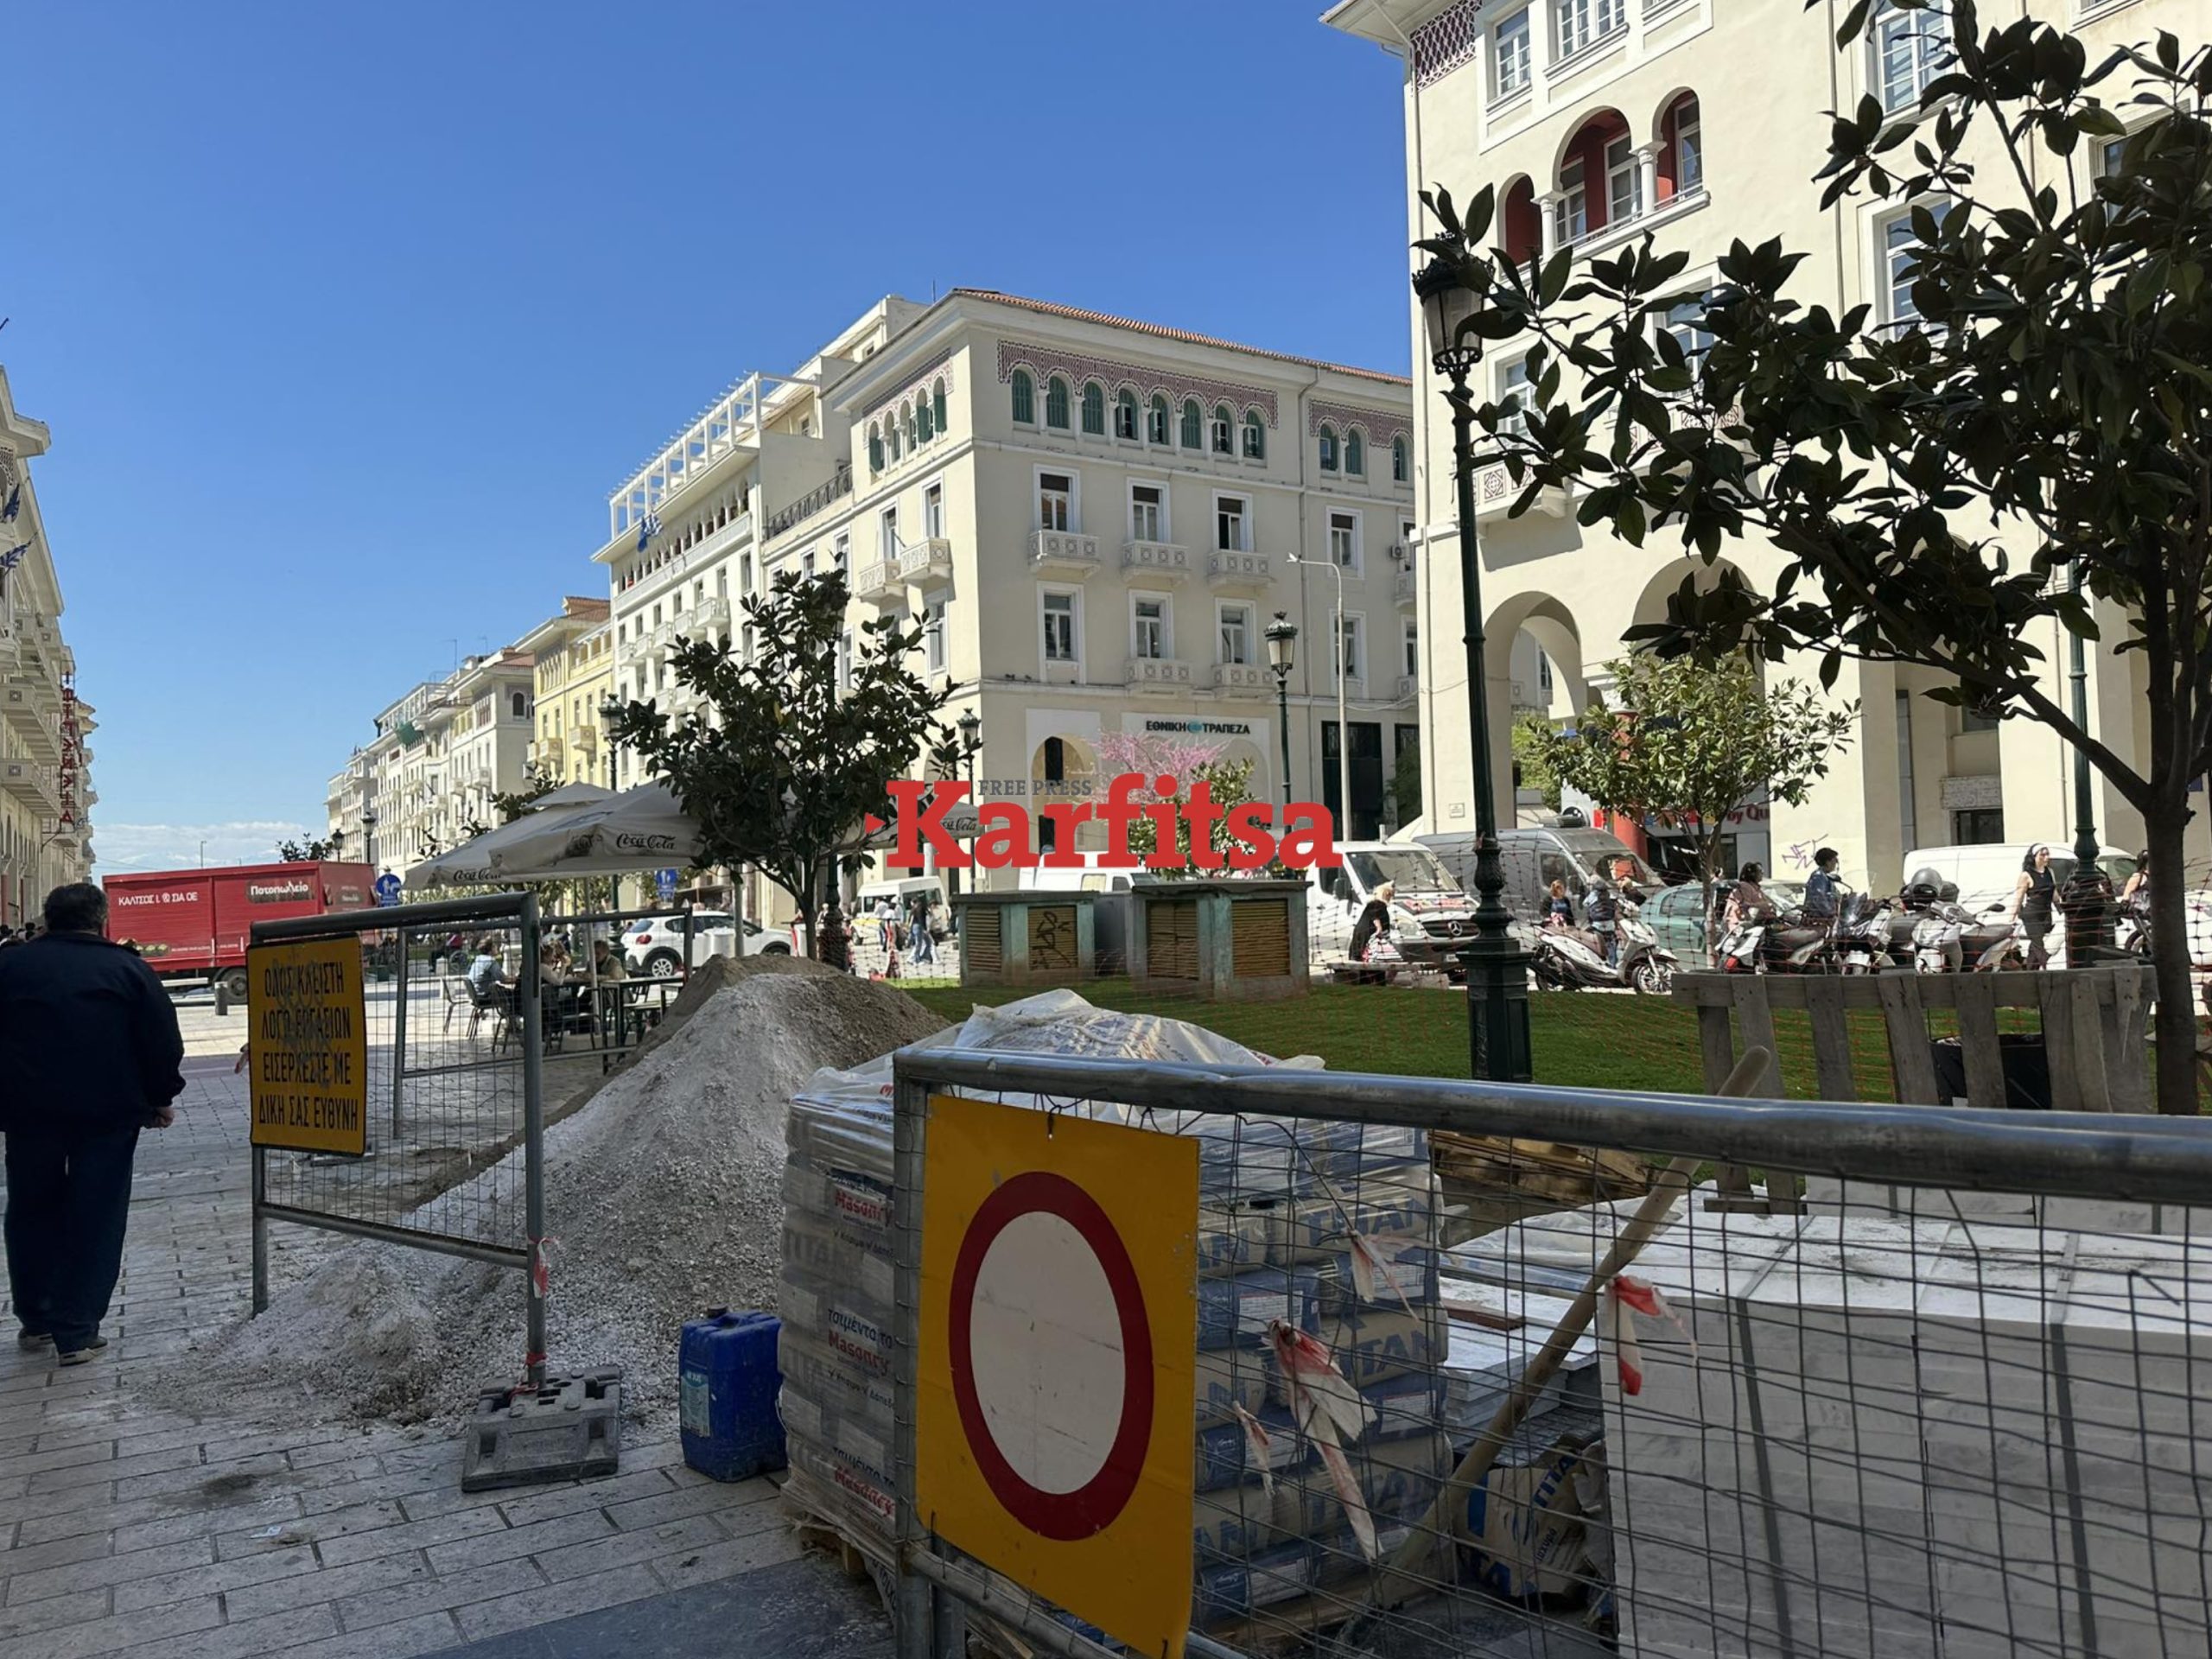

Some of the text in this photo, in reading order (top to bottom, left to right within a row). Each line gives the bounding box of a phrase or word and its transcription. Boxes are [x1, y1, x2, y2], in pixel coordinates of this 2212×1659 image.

[1146, 721, 1250, 734] ΕΘΝΙΚΗ ΤΡΑΠΕΖΑ
[251, 880, 308, 896] Ποτοπωλείο
[297, 962, 344, 995] ΚΛΕΙΣΤΗ
[334, 1052, 352, 1085] ΜΕ
[259, 1095, 359, 1132] ΔΙΚΗ ΣΑΣ ΕΥΘΥΝΗ
[834, 1189, 893, 1228] Masonry
[828, 1329, 890, 1376] Masonry
[835, 1465, 896, 1518] Masonry
